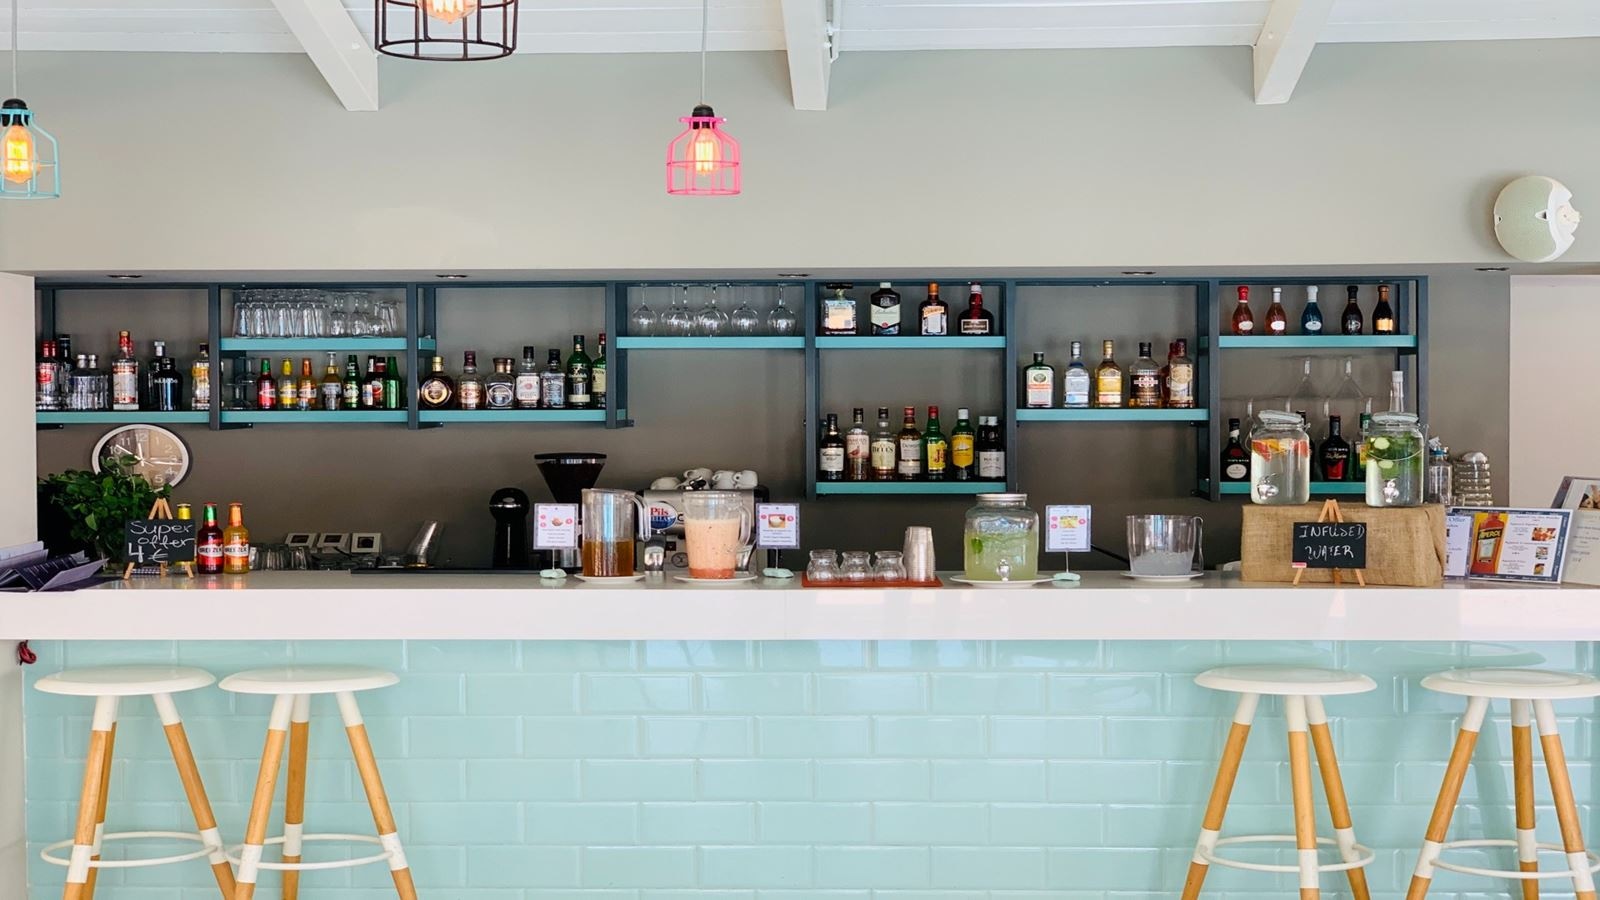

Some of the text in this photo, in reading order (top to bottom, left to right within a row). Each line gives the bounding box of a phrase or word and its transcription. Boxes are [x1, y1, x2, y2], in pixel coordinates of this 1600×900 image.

[650, 507, 669, 516] Pils
[130, 520, 193, 540] Super
[1299, 523, 1365, 540] INFUSED
[1304, 544, 1354, 561] WATER
